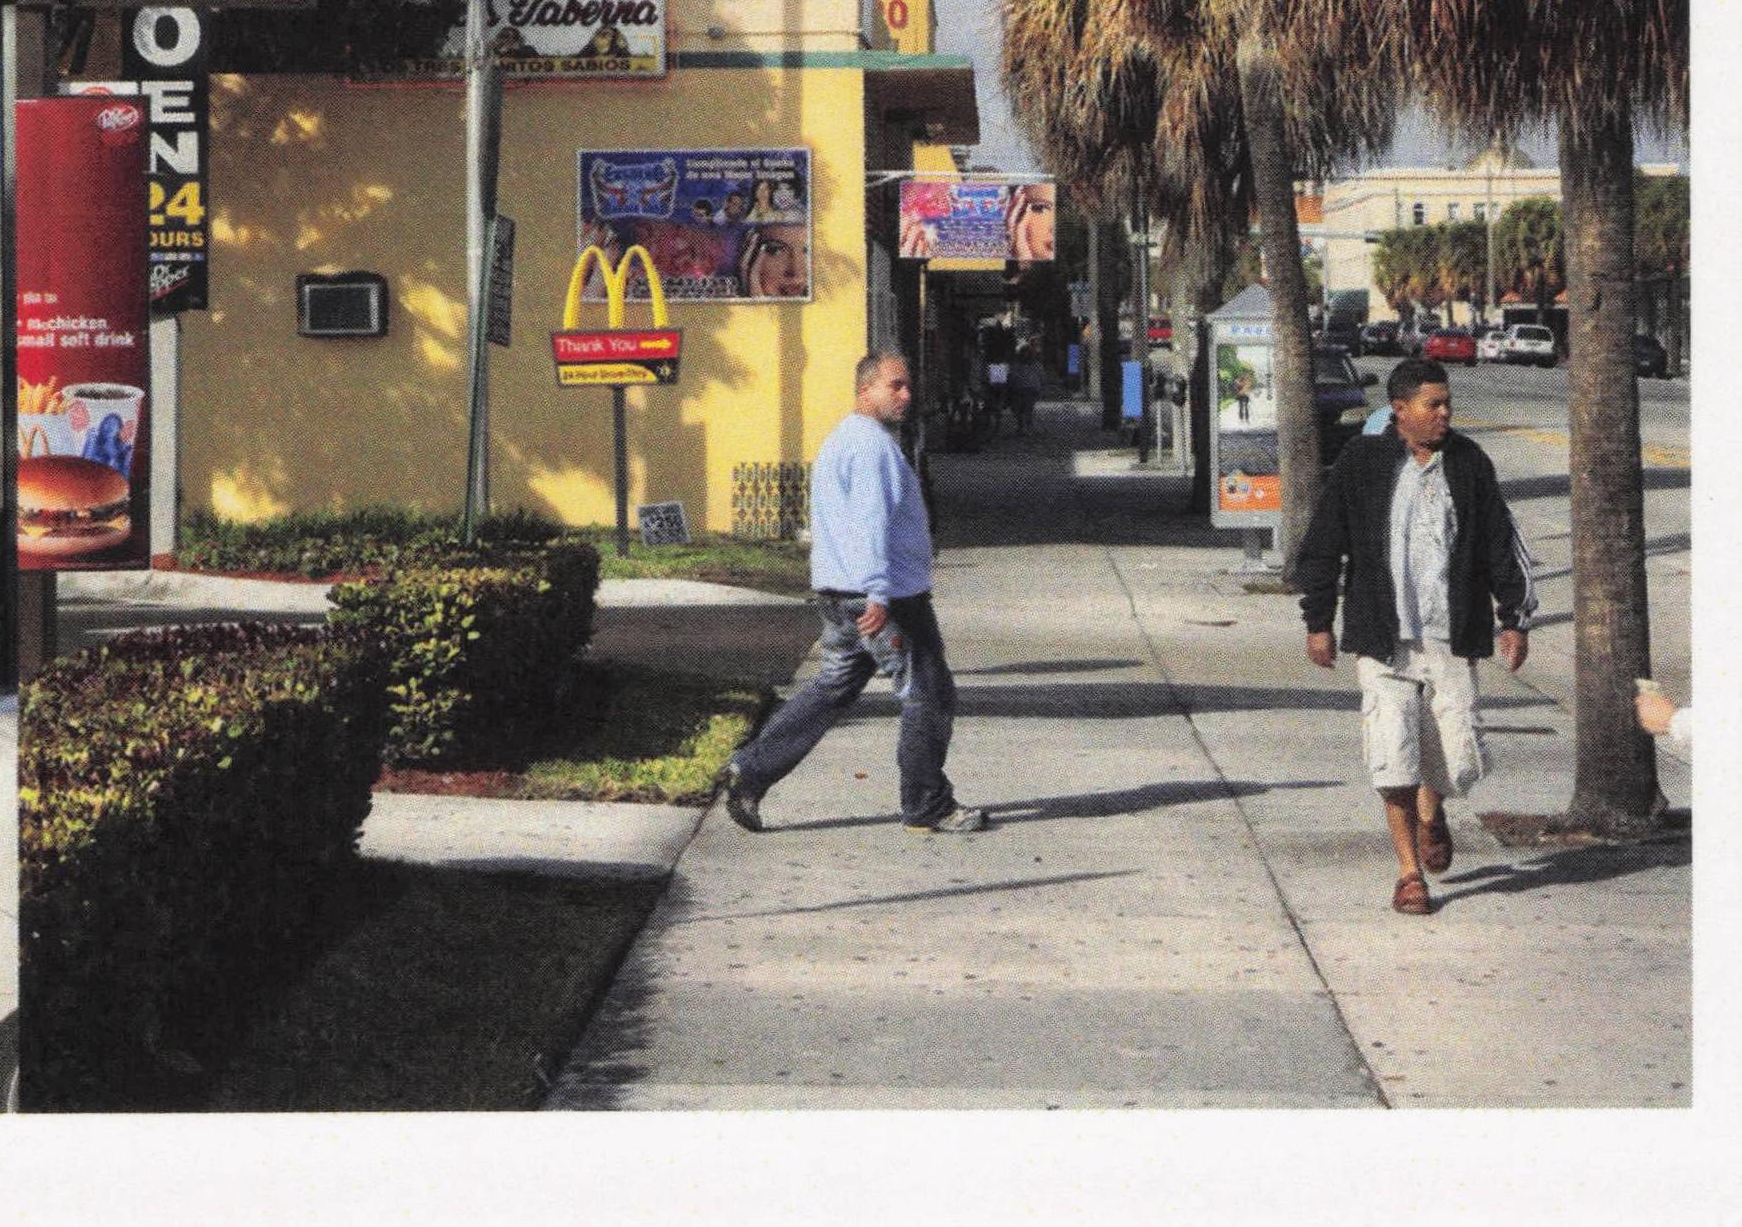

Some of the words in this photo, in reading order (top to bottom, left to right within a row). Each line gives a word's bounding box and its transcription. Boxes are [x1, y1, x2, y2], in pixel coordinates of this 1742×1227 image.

[60, 332, 90, 347] soft
[94, 330, 135, 347] drink
[557, 337, 604, 353] Thank
[609, 337, 637, 352] You
